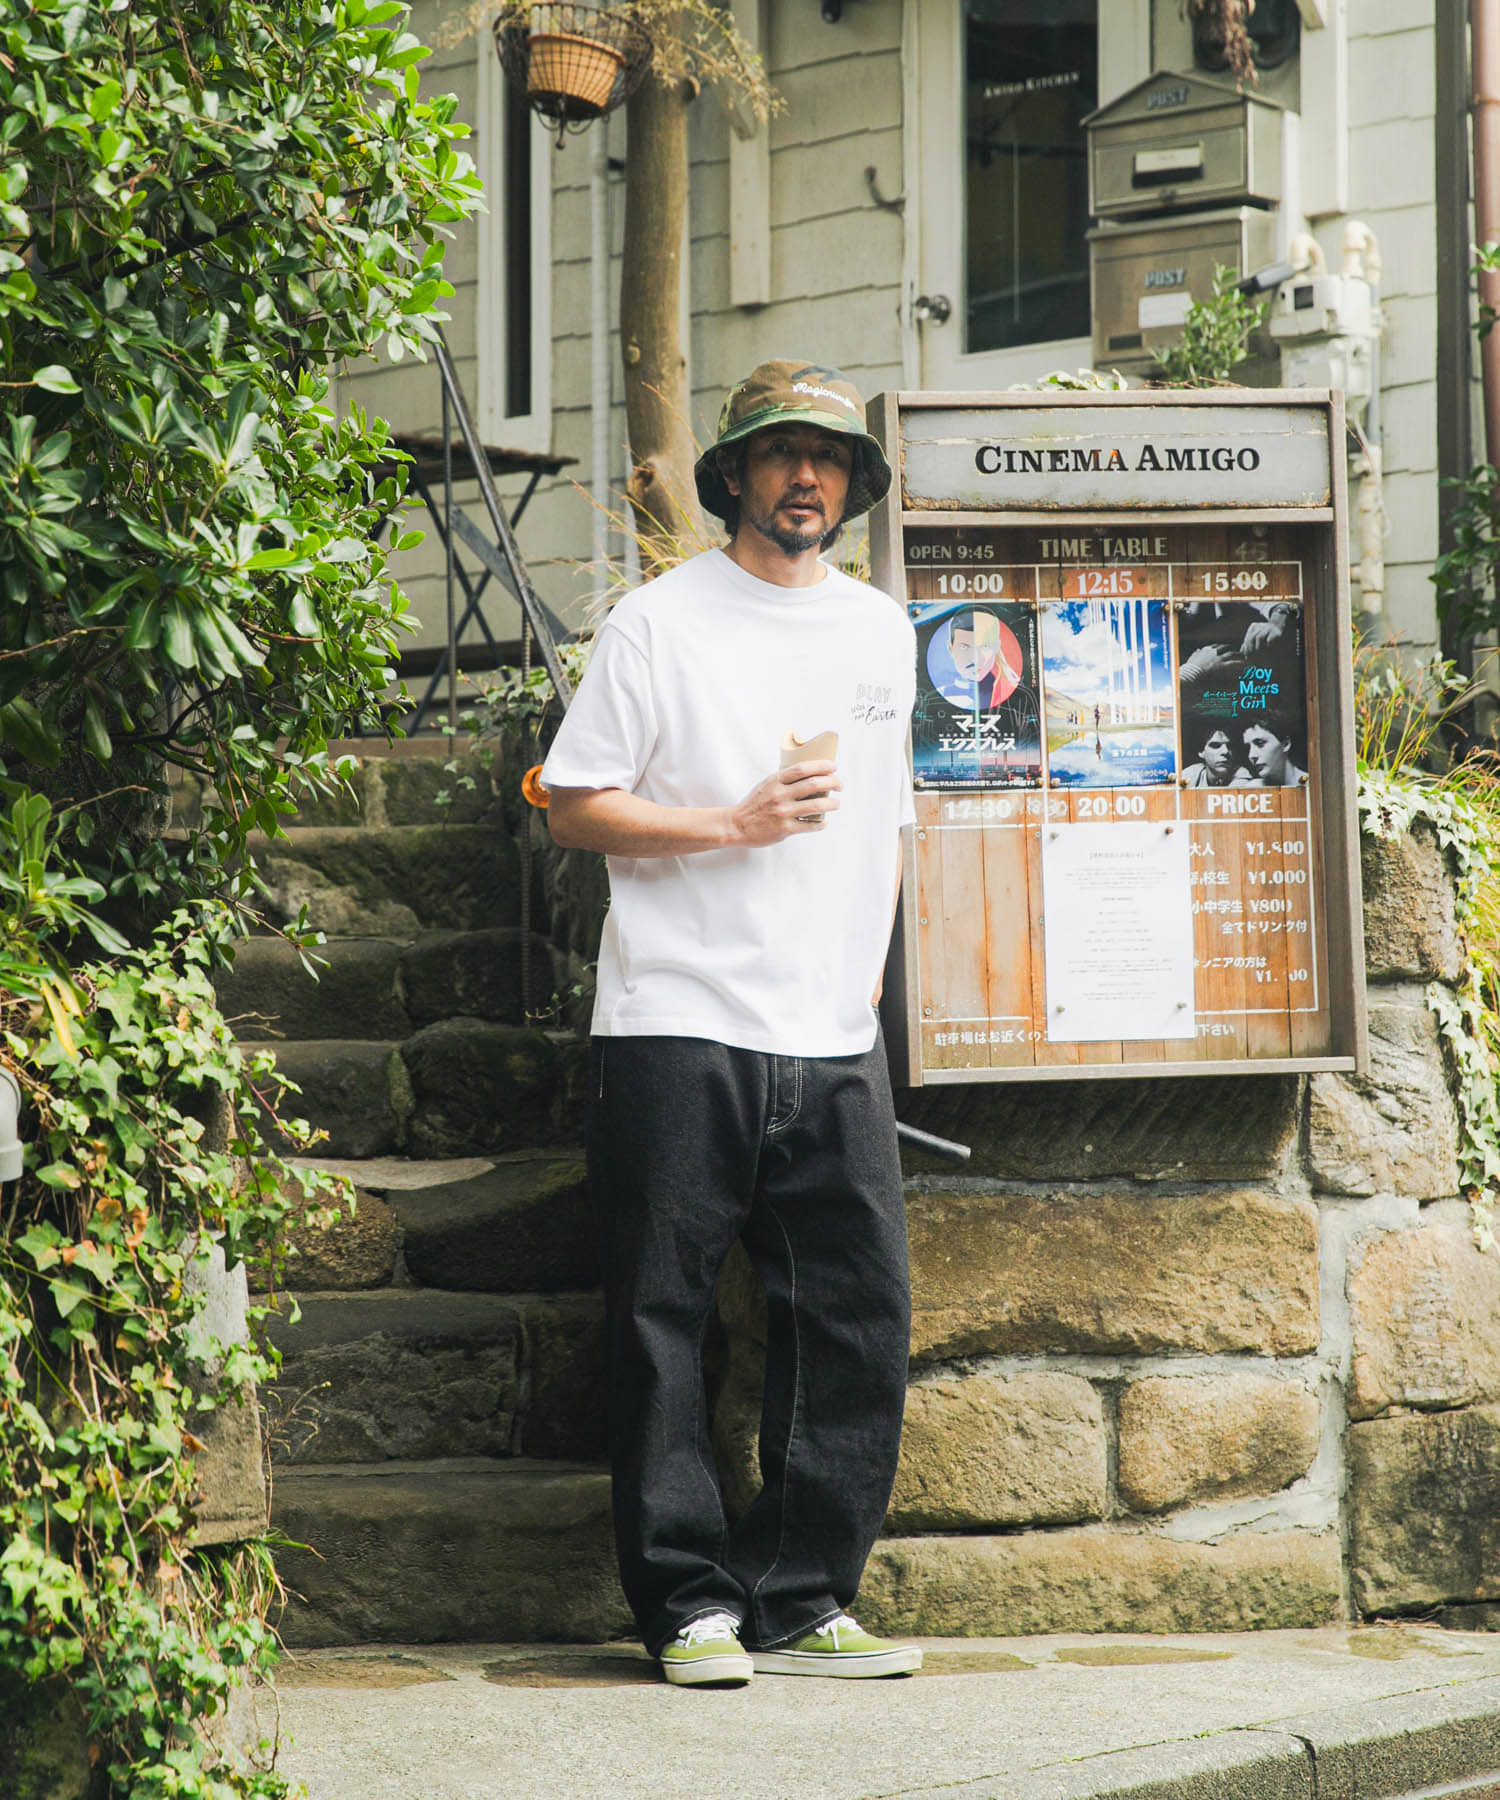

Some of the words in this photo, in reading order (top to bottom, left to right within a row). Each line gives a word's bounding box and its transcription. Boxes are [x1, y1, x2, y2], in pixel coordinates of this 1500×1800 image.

[1144, 267, 1185, 287] POST
[974, 444, 1127, 474] CINEMA
[1135, 444, 1261, 472] AMIGO
[910, 545, 952, 561] OPEN
[956, 543, 995, 560] 9:45
[1038, 537, 1092, 559] TIME
[1102, 536, 1168, 557] TABLE
[937, 574, 1004, 594] 10:00
[1077, 570, 1134, 595] 12:15
[1201, 571, 1268, 592] 15:00
[1238, 665, 1273, 683] Boy
[1239, 680, 1280, 695] Meets
[1240, 695, 1266, 710] Girl
[1078, 796, 1146, 815] 20:00
[1208, 793, 1274, 814] PRICE
[1189, 841, 1216, 856] 大人
[1222, 919, 1308, 934] 全てドリンク付
[1256, 968, 1308, 983] ¥1.00
[935, 1029, 1048, 1047] 駐車場はお近くの
